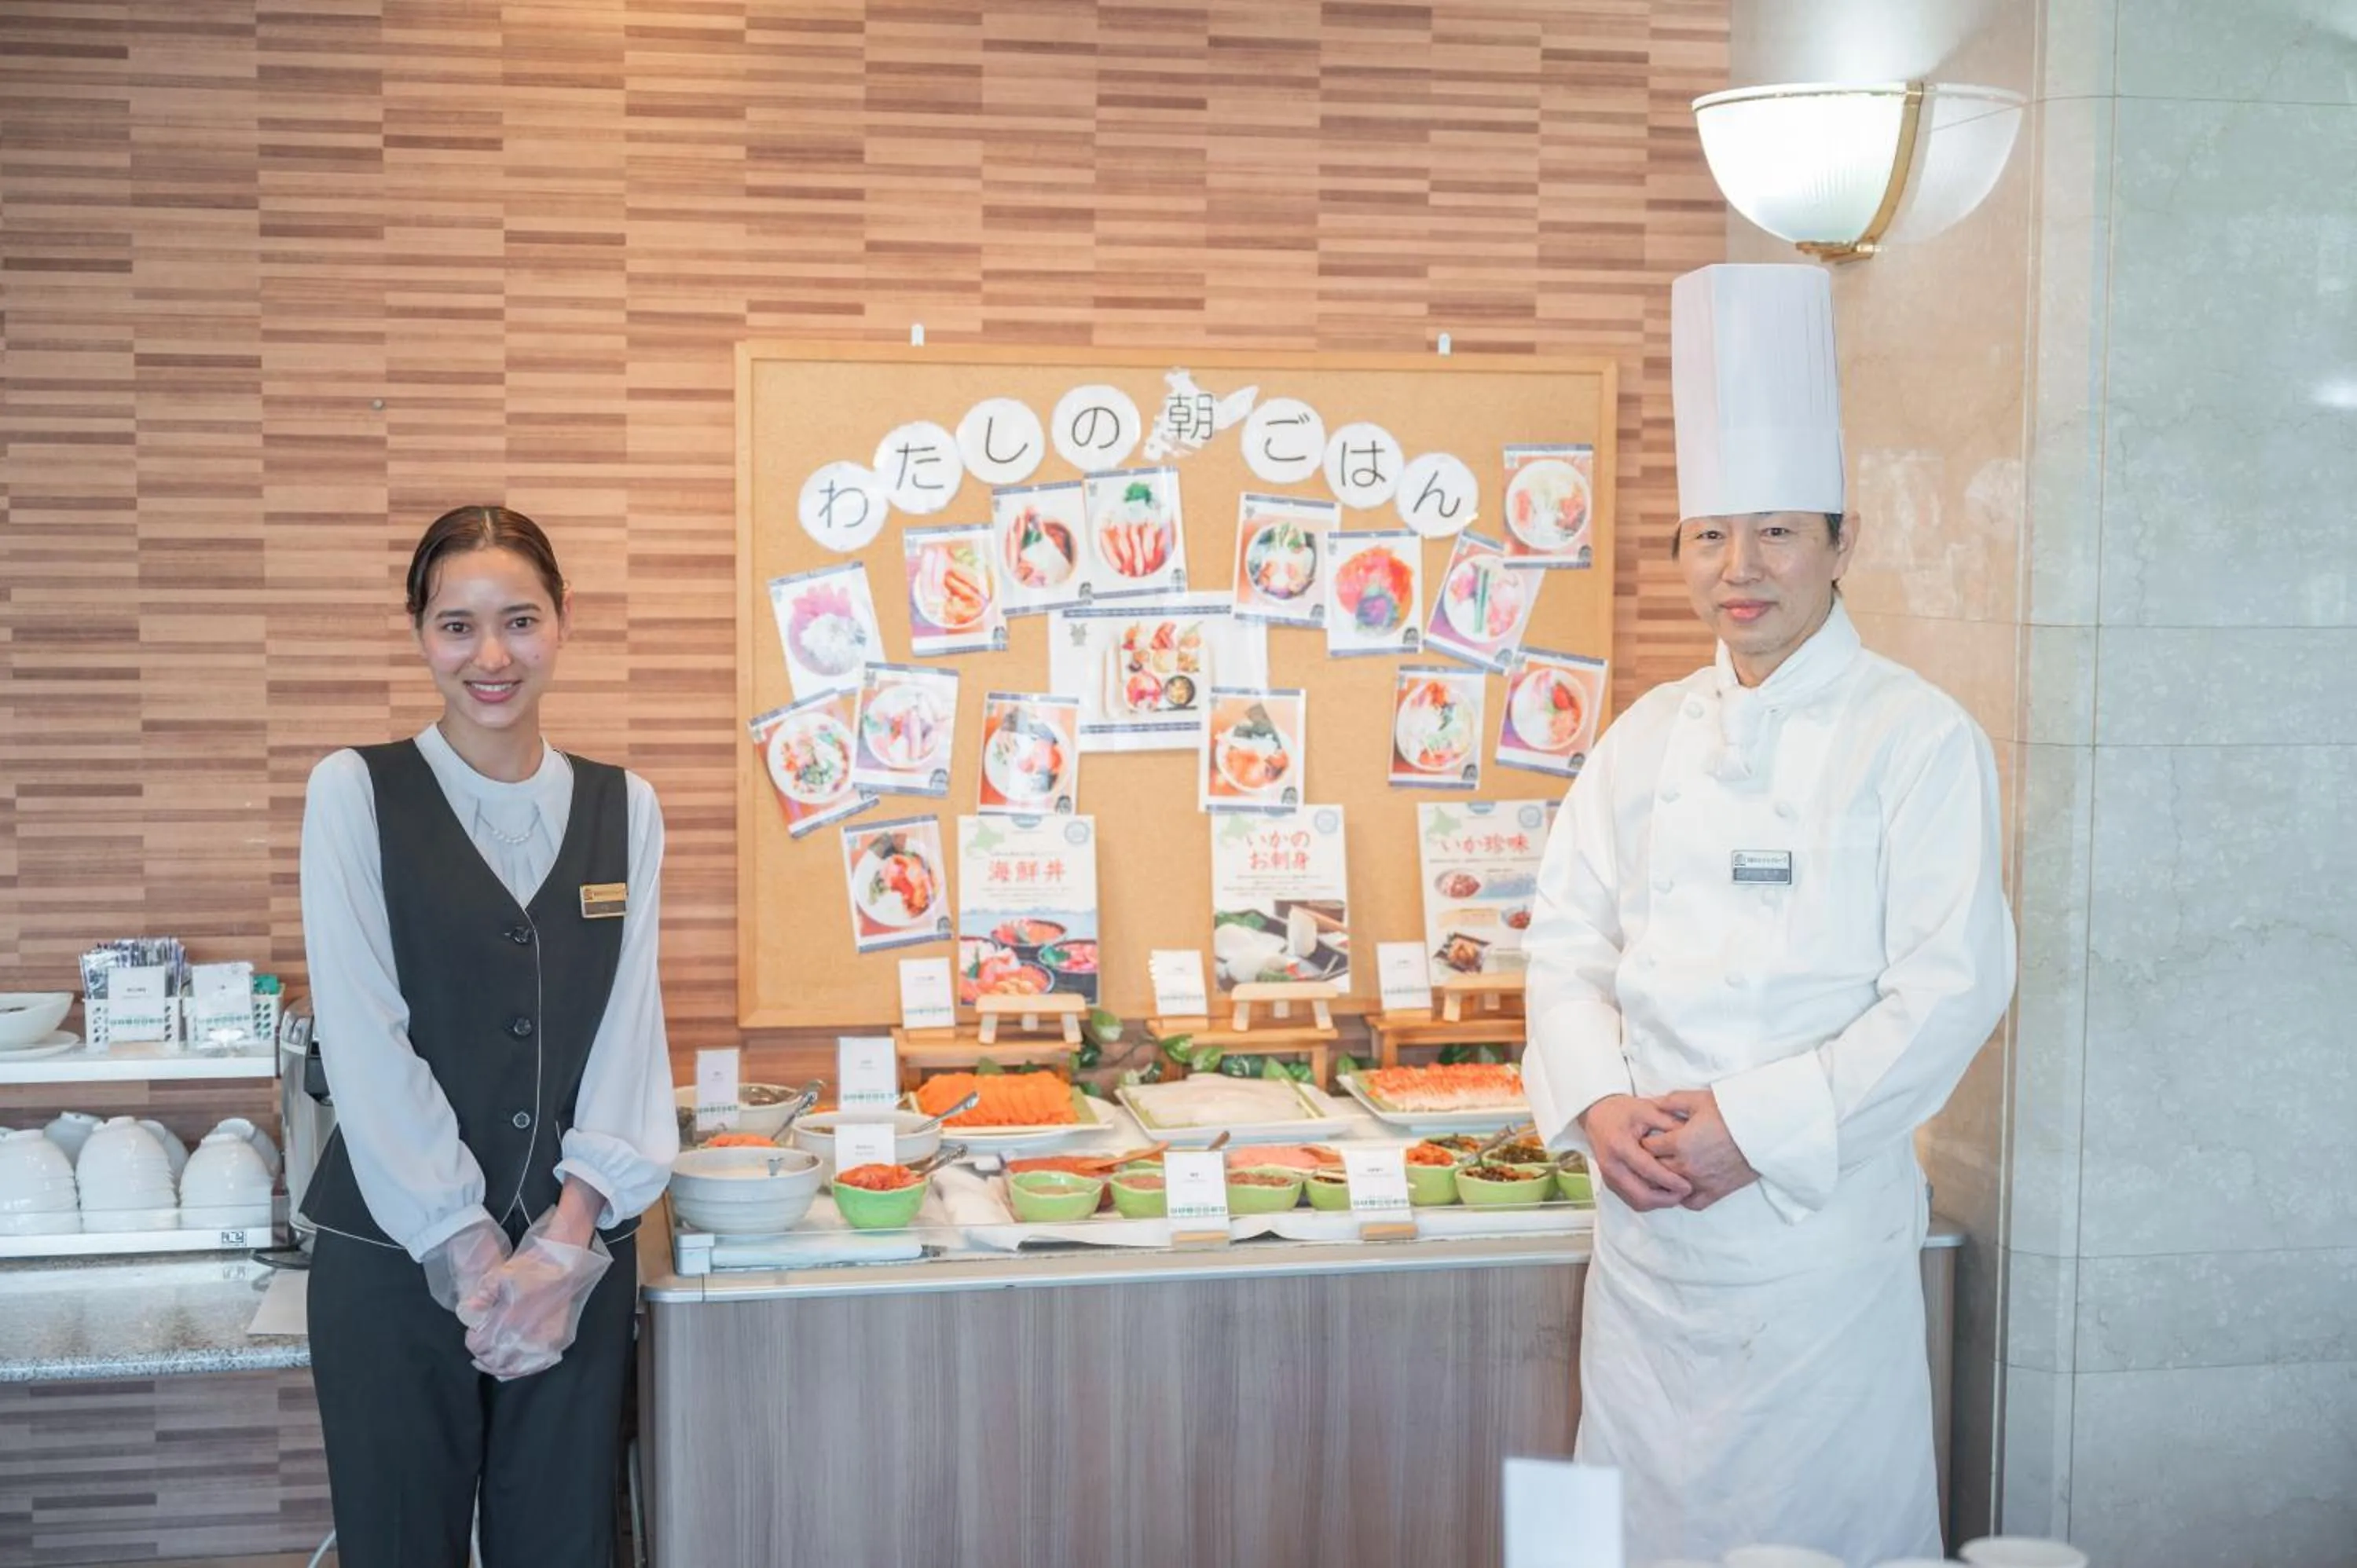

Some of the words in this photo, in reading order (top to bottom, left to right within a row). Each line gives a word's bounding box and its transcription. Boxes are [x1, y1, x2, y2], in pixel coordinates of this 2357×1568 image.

[817, 392, 1461, 529] わたしの朝ごはん
[1246, 830, 1311, 848] いかの
[1248, 851, 1311, 870] お刺身
